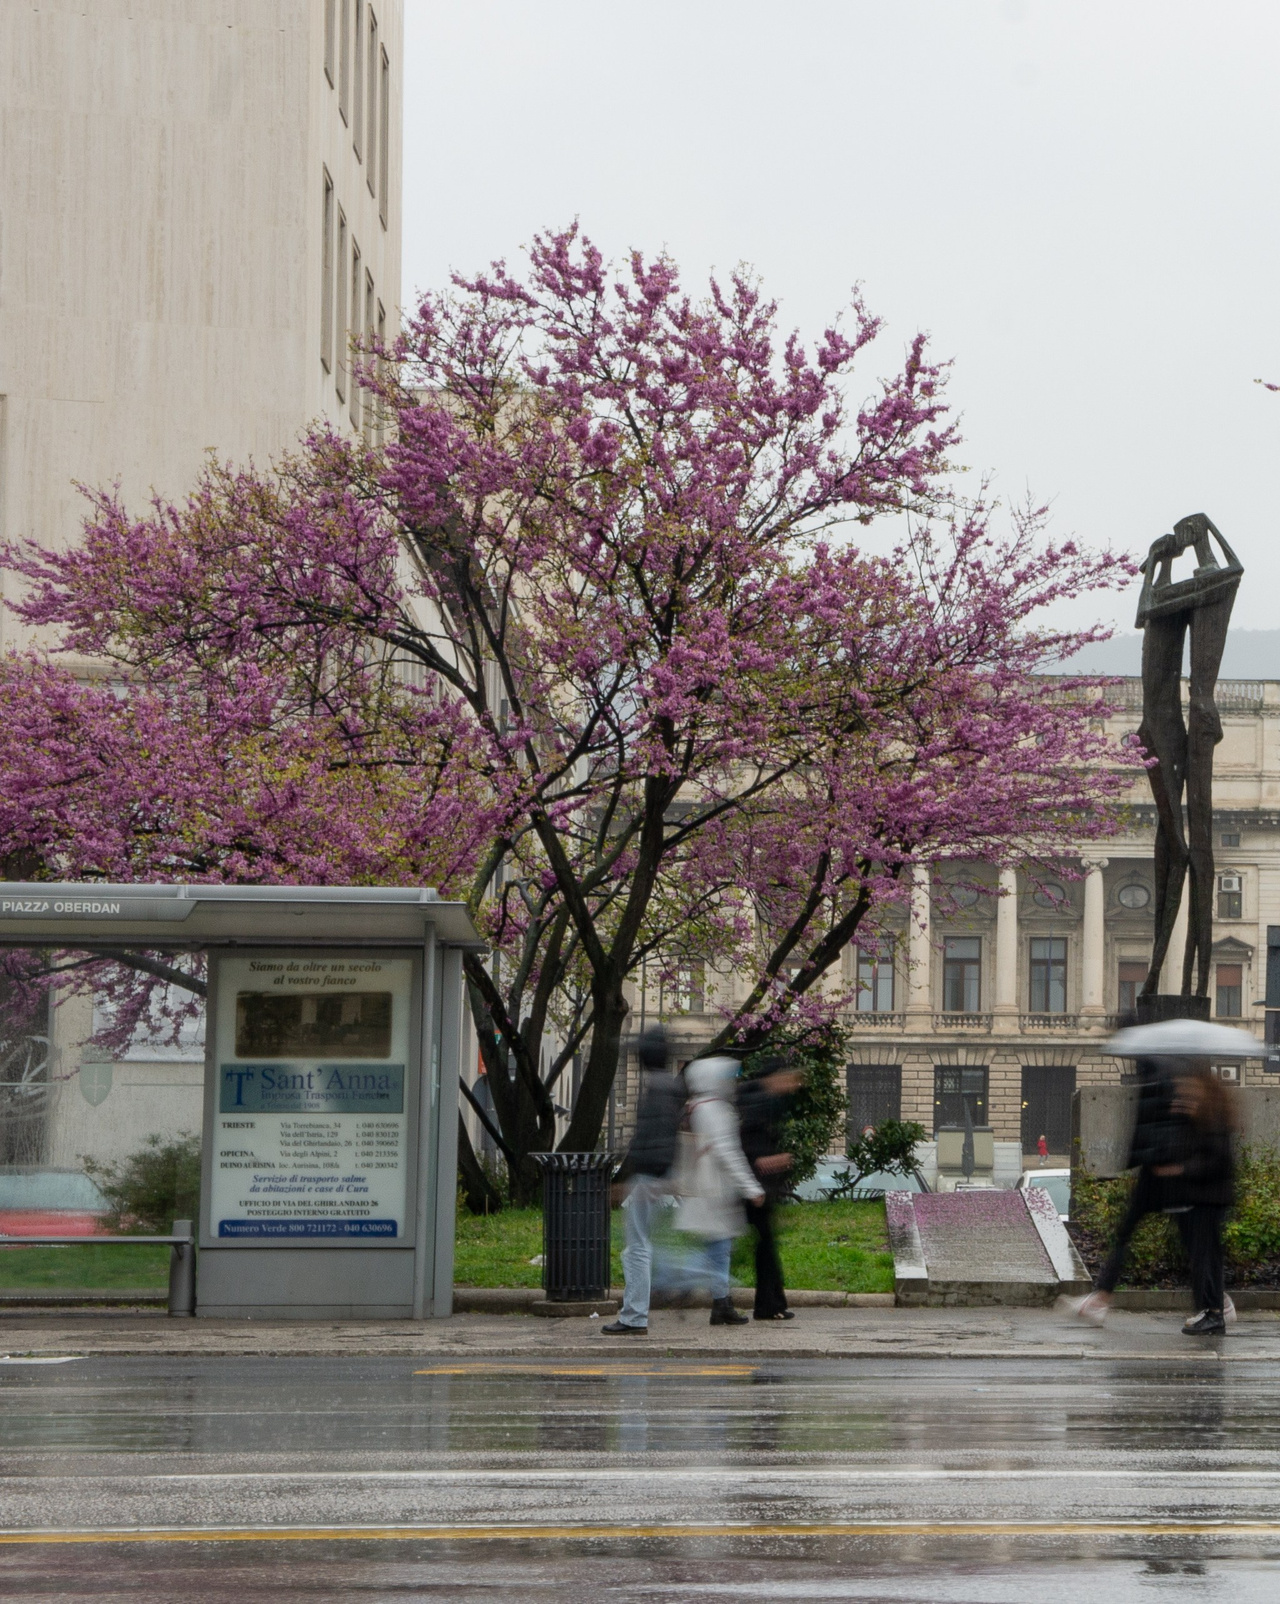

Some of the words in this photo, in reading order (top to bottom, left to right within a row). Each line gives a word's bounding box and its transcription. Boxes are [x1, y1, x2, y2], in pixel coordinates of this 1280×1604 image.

[2, 902, 50, 912] PIAZZA
[54, 902, 120, 913] OBERDAN
[249, 962, 283, 972] Siamo
[286, 962, 300, 972] da
[302, 962, 327, 972] oltre
[331, 964, 344, 972] un
[348, 962, 382, 972] secolo
[288, 975, 320, 984] vostro
[320, 975, 356, 987] fianco
[292, 1150, 308, 1159] degli
[252, 1175, 286, 1183] Servizio
[300, 1175, 339, 1184] trasporto
[341, 1175, 366, 1183] salme
[262, 1184, 305, 1193] abitazioni
[346, 1184, 368, 1192] Cura
[224, 1224, 259, 1232] Numero
[262, 1224, 286, 1232] Verde
[289, 1224, 304, 1232] 800
[307, 1224, 336, 1232] 721172
[344, 1224, 360, 1232] 040
[362, 1224, 392, 1232] 630696
